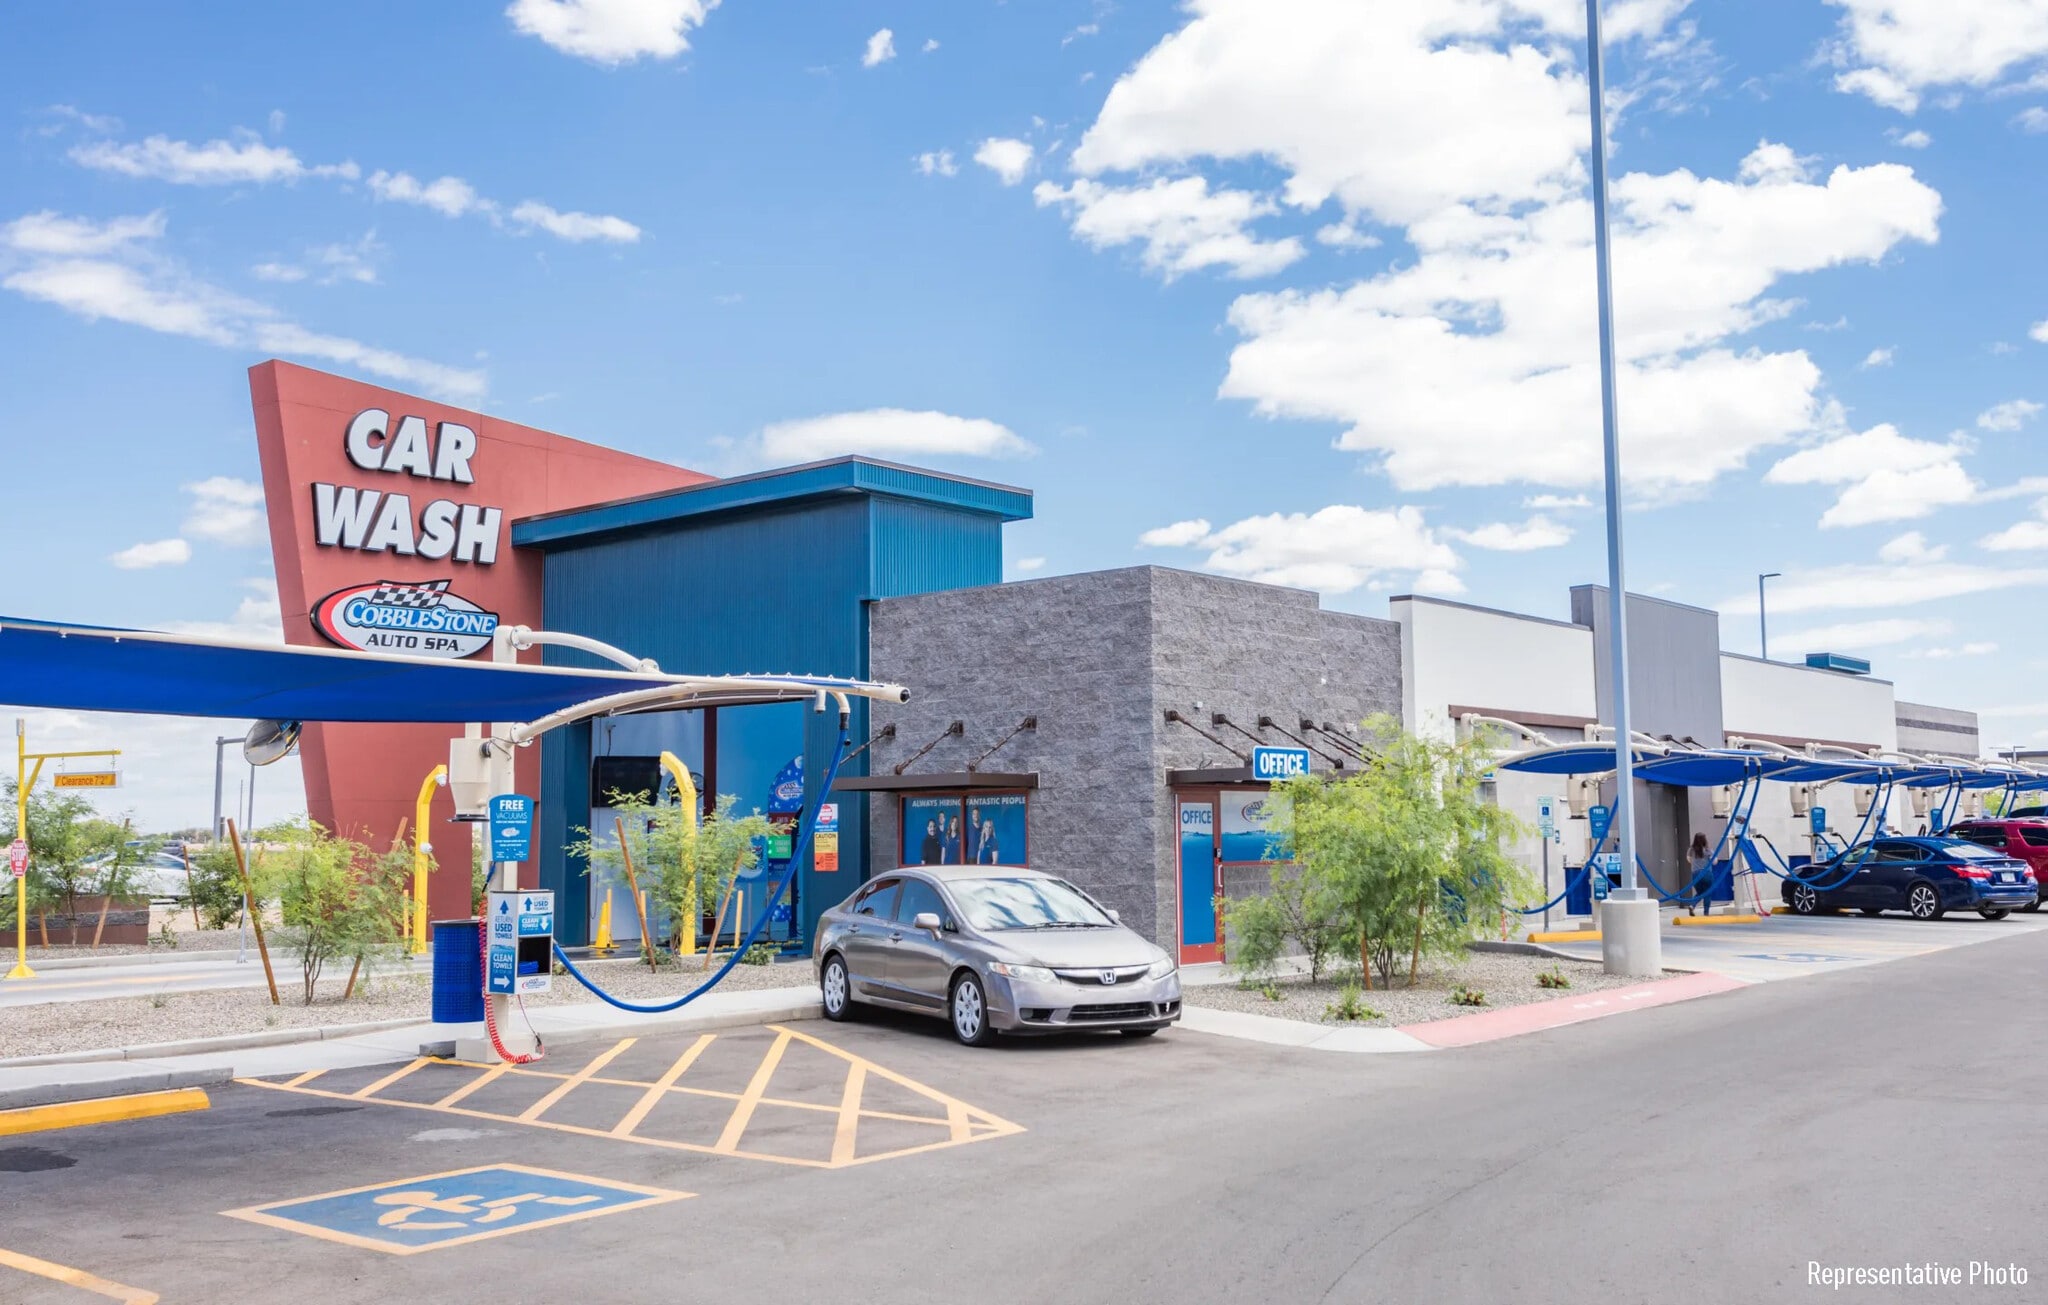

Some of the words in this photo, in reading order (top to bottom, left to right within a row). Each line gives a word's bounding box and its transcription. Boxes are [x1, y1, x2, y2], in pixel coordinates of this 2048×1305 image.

[345, 408, 478, 484] CAR
[311, 482, 503, 565] WASH
[347, 600, 497, 634] COBBLESTONE
[365, 633, 418, 649] AUTO
[424, 637, 459, 651] SPA
[1259, 752, 1304, 775] OFFICE
[61, 775, 94, 786] Clearance
[500, 800, 524, 810] FREE
[912, 800, 938, 808] ALWAYS
[966, 797, 1000, 806] FANTASTIC
[1001, 796, 1026, 805] PEOPLE
[496, 811, 528, 820] VACUUMS
[1181, 810, 1212, 824] OFFICE
[12, 848, 26, 861] STOP
[495, 923, 513, 932] USED
[493, 953, 513, 963] CLEAN
[493, 962, 513, 970] TOWELS
